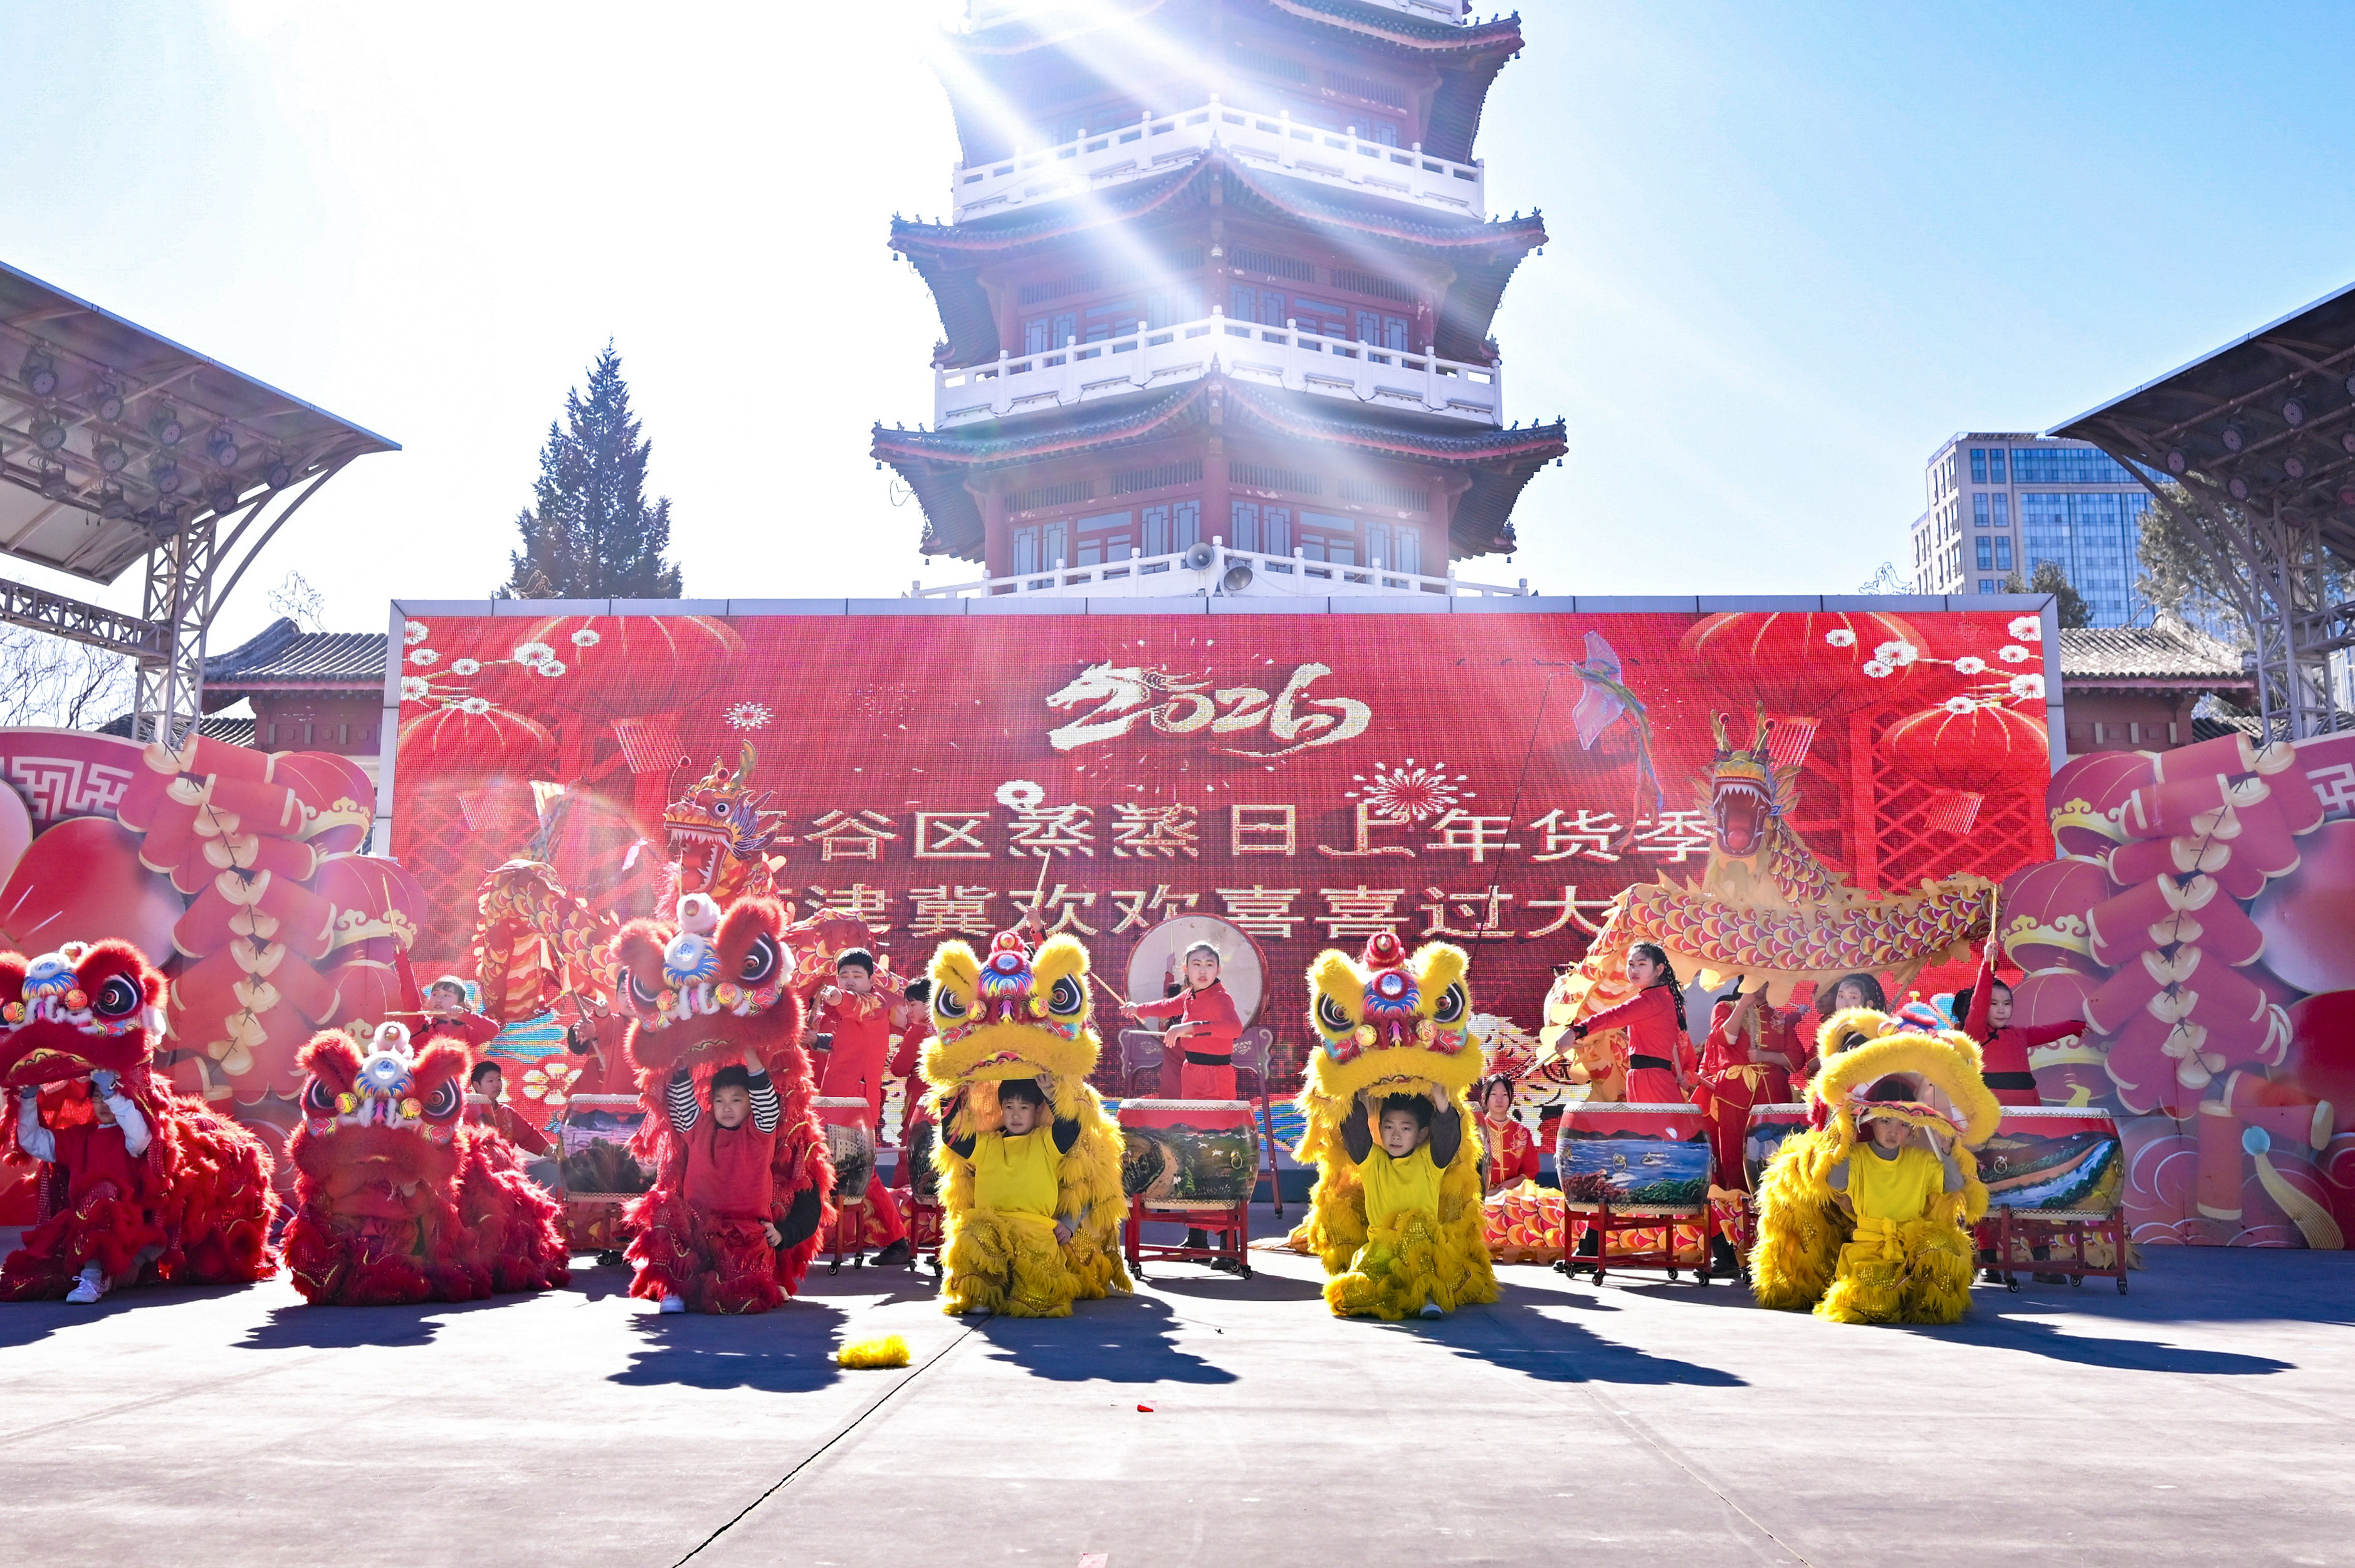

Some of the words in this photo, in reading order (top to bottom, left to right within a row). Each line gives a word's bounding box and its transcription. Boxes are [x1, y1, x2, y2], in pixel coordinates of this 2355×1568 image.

[1045, 660, 1372, 758] 2026
[778, 884, 1618, 939] 津冀欢欢喜喜过大
